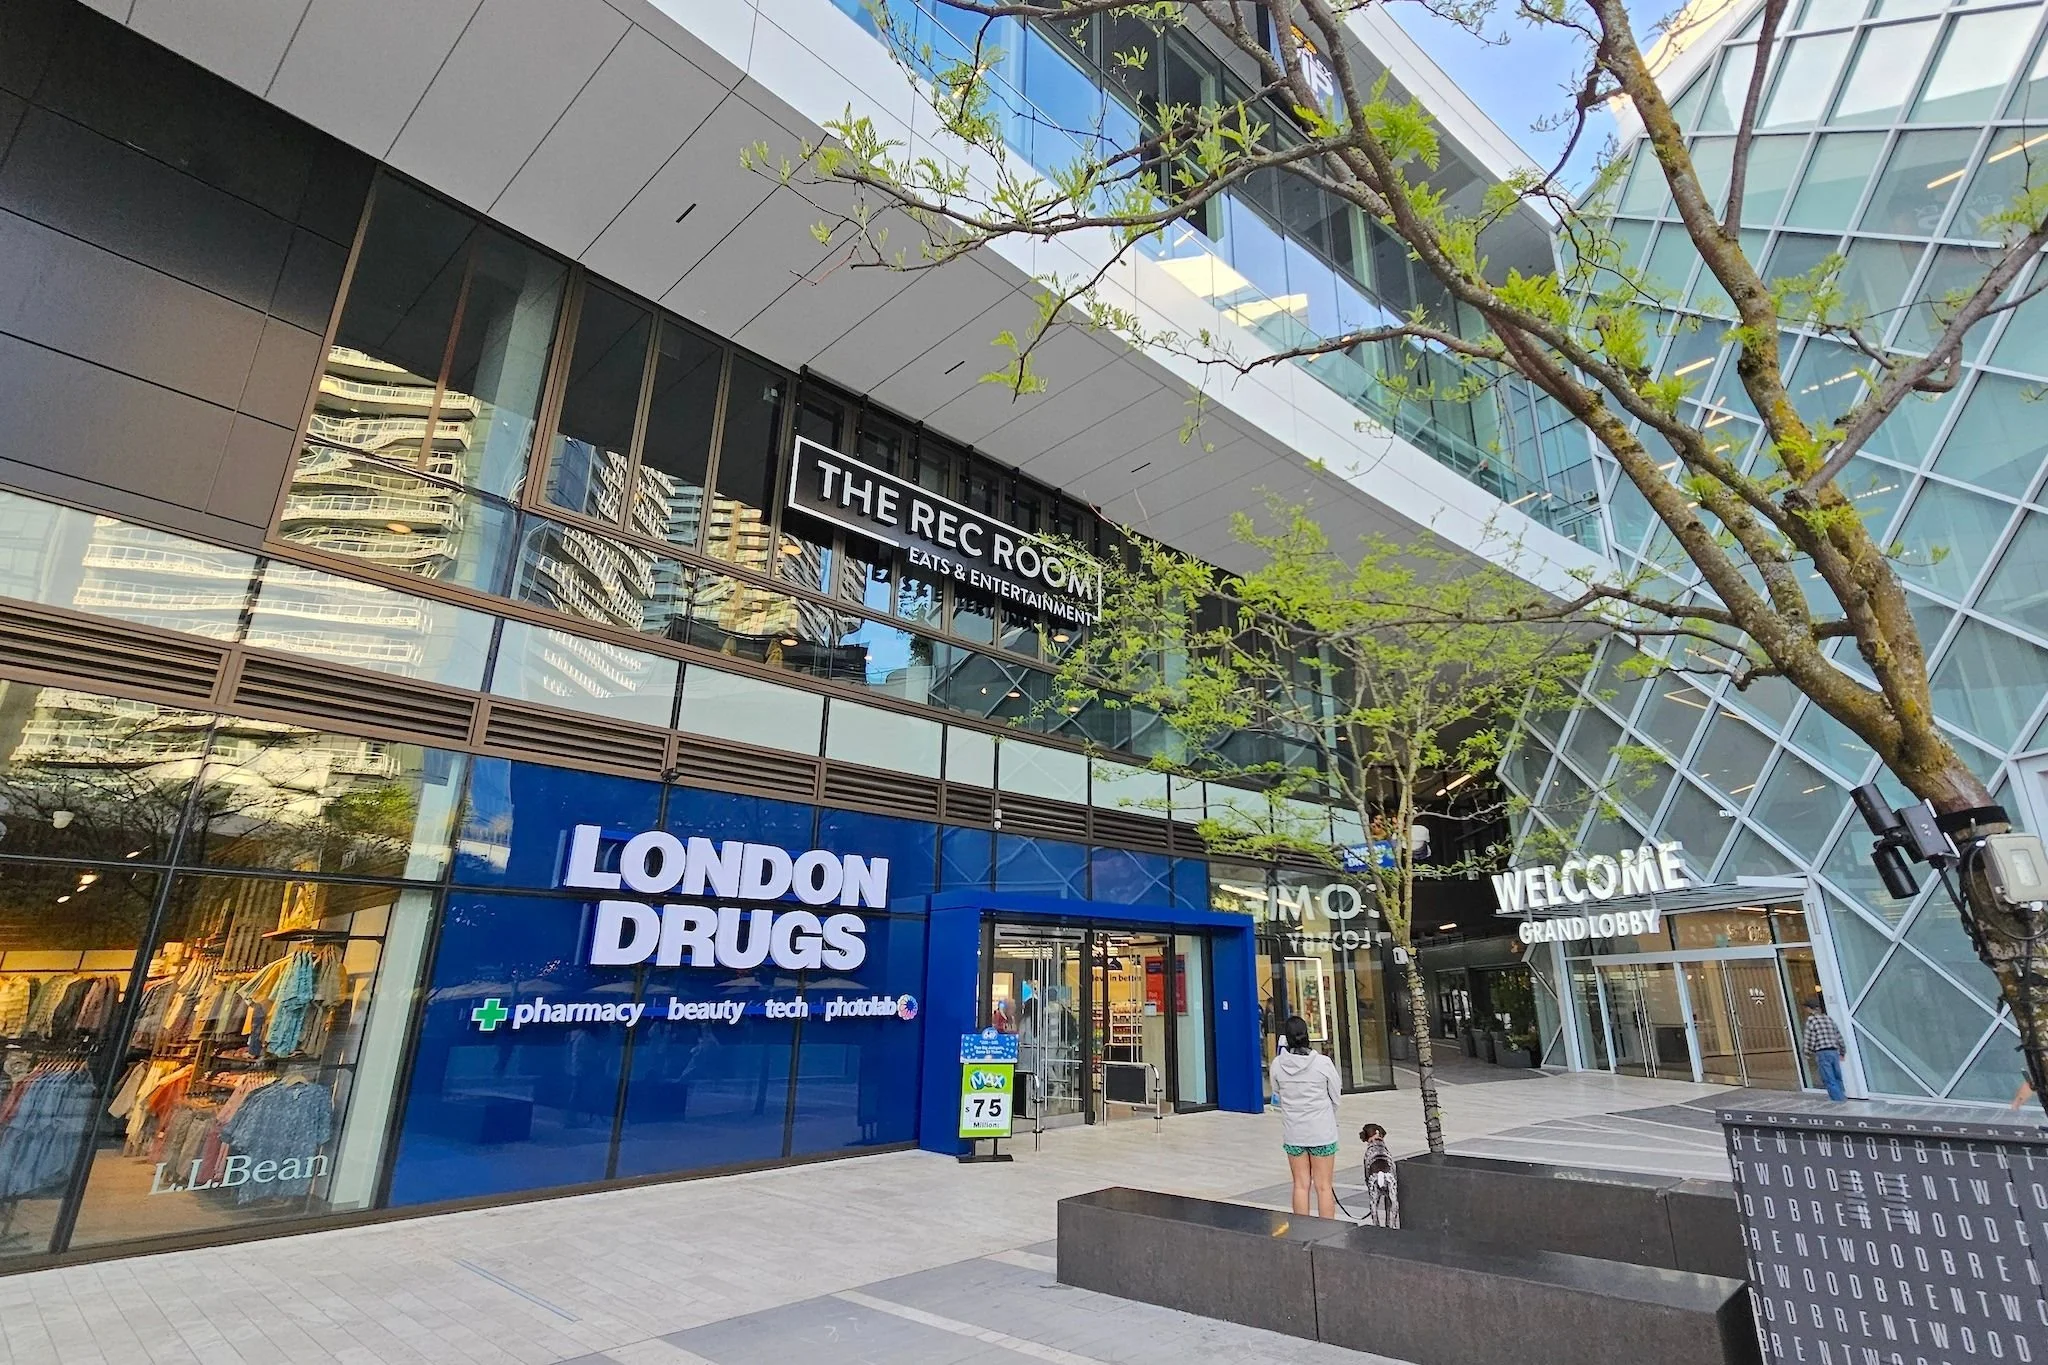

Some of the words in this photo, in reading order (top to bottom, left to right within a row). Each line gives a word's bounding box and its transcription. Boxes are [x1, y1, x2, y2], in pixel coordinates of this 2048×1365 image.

[817, 459, 899, 525] THE
[911, 498, 983, 557] REC
[993, 534, 1093, 601] ROOM
[909, 546, 950, 575] EATS
[954, 563, 966, 582] &
[970, 569, 1093, 627] ENTERTAINMENT
[563, 824, 889, 909] LONDON
[1491, 841, 1690, 914] WELCOME
[590, 900, 866, 970] DRUGS
[1518, 917, 1589, 945] GRAND
[1588, 909, 1661, 939] LOBBY
[512, 997, 645, 1030] pharmacy
[667, 997, 746, 1025] beauty
[765, 996, 809, 1019] tech
[825, 995, 897, 1021] photolab
[971, 1072, 1005, 1090] MAX
[149, 1154, 329, 1195] L.L.Bean
